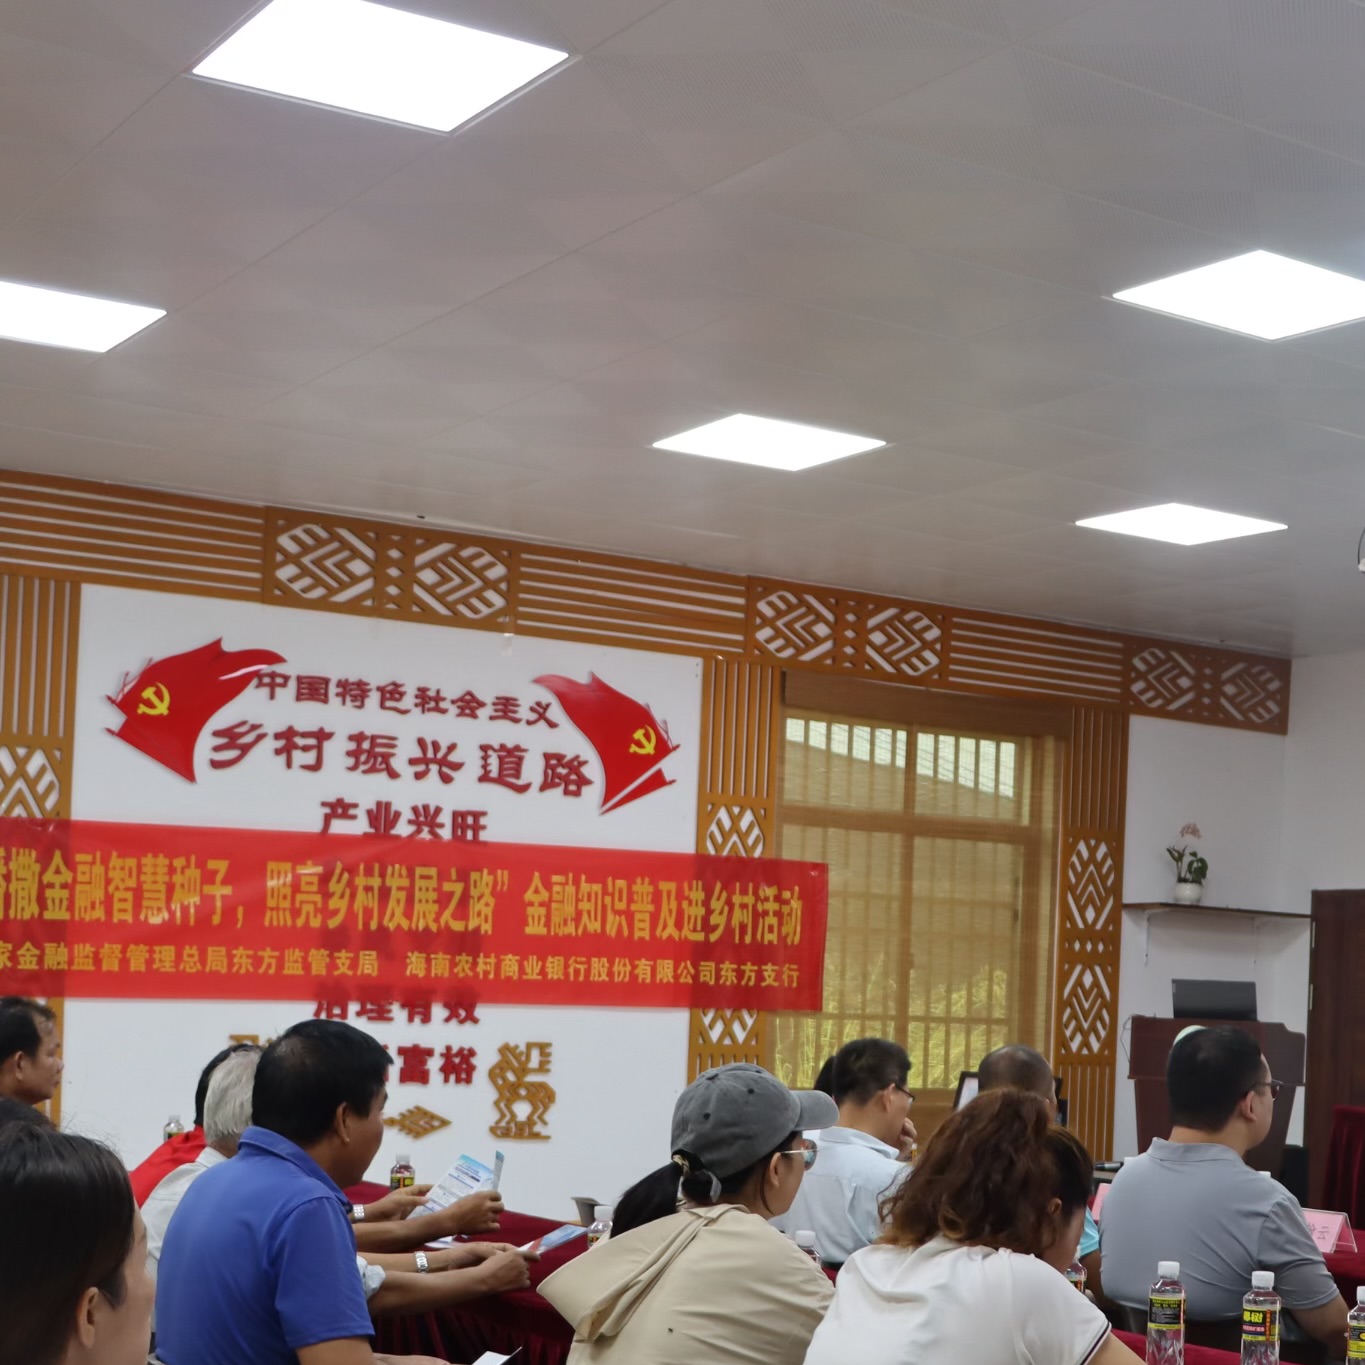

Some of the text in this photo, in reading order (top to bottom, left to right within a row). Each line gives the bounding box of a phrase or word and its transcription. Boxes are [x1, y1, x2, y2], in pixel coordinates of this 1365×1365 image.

[255, 670, 560, 730] 中国特色社会主义
[209, 720, 595, 799] 乡村振兴道路
[0, 846, 802, 947] 撒金融智慧种子，照亮乡村发展之路” 金融知识普及进乡村活动
[406, 950, 800, 989] 海南农村商业银行股份有限公司东方支行
[383, 1043, 478, 1085] 富裕
